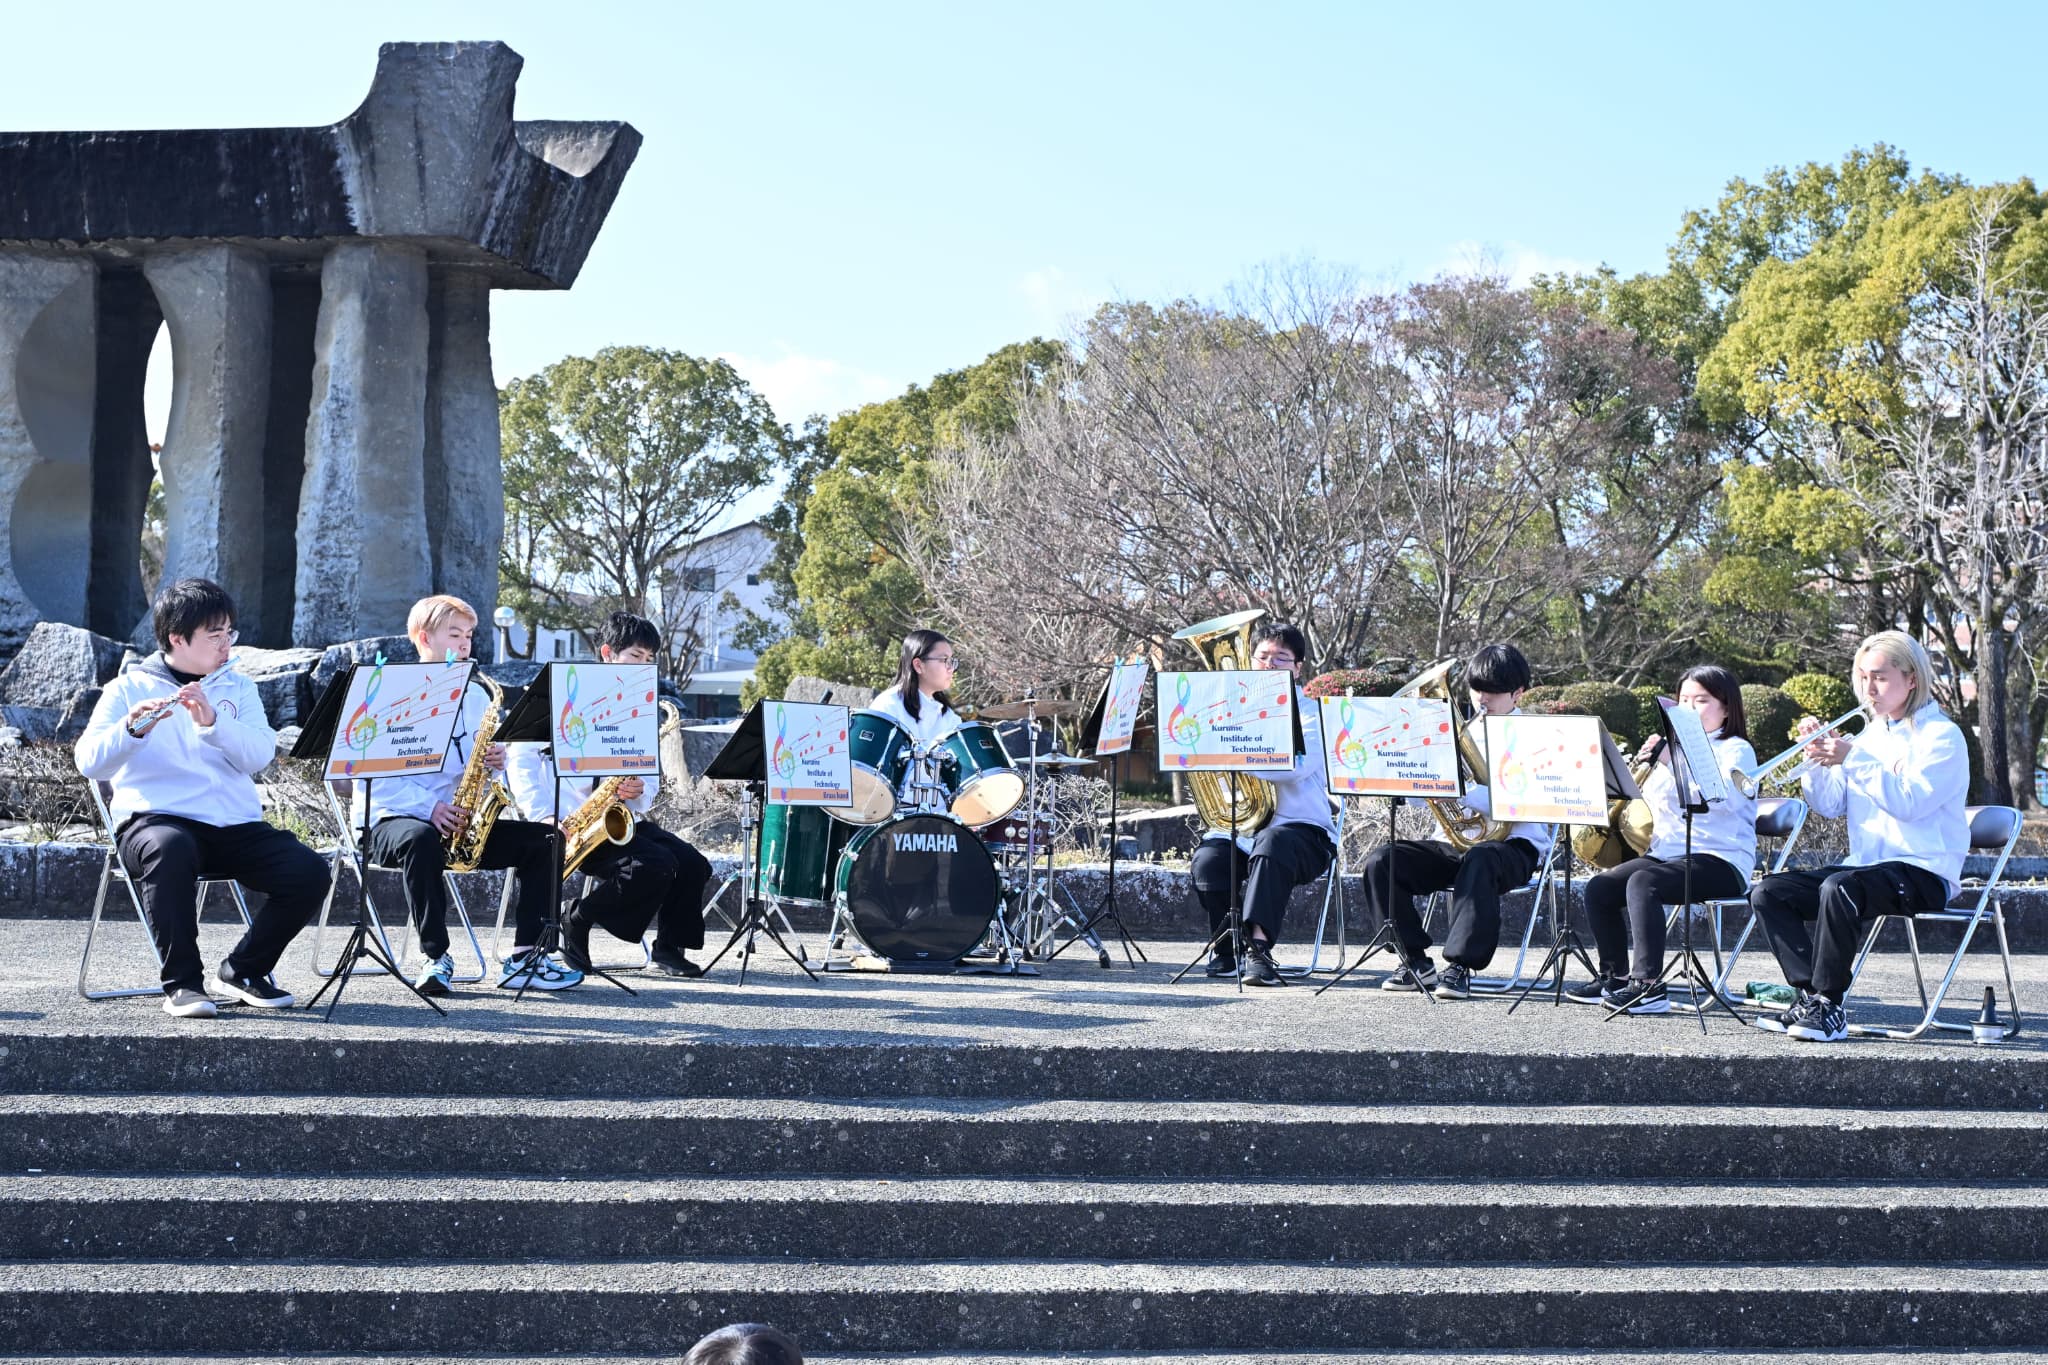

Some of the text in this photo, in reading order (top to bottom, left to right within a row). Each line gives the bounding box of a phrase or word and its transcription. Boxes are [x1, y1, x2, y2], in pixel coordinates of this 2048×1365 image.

[391, 736, 419, 744] Institute
[602, 736, 627, 744] Institute
[397, 746, 433, 756] Technology
[610, 748, 645, 756] Technology
[1232, 745, 1275, 755] Technology
[406, 759, 422, 767] Brass
[1398, 771, 1440, 781] Technology
[1553, 796, 1592, 808] Technology
[1567, 808, 1604, 817] Brass band
[893, 833, 958, 852] YAMAHA
